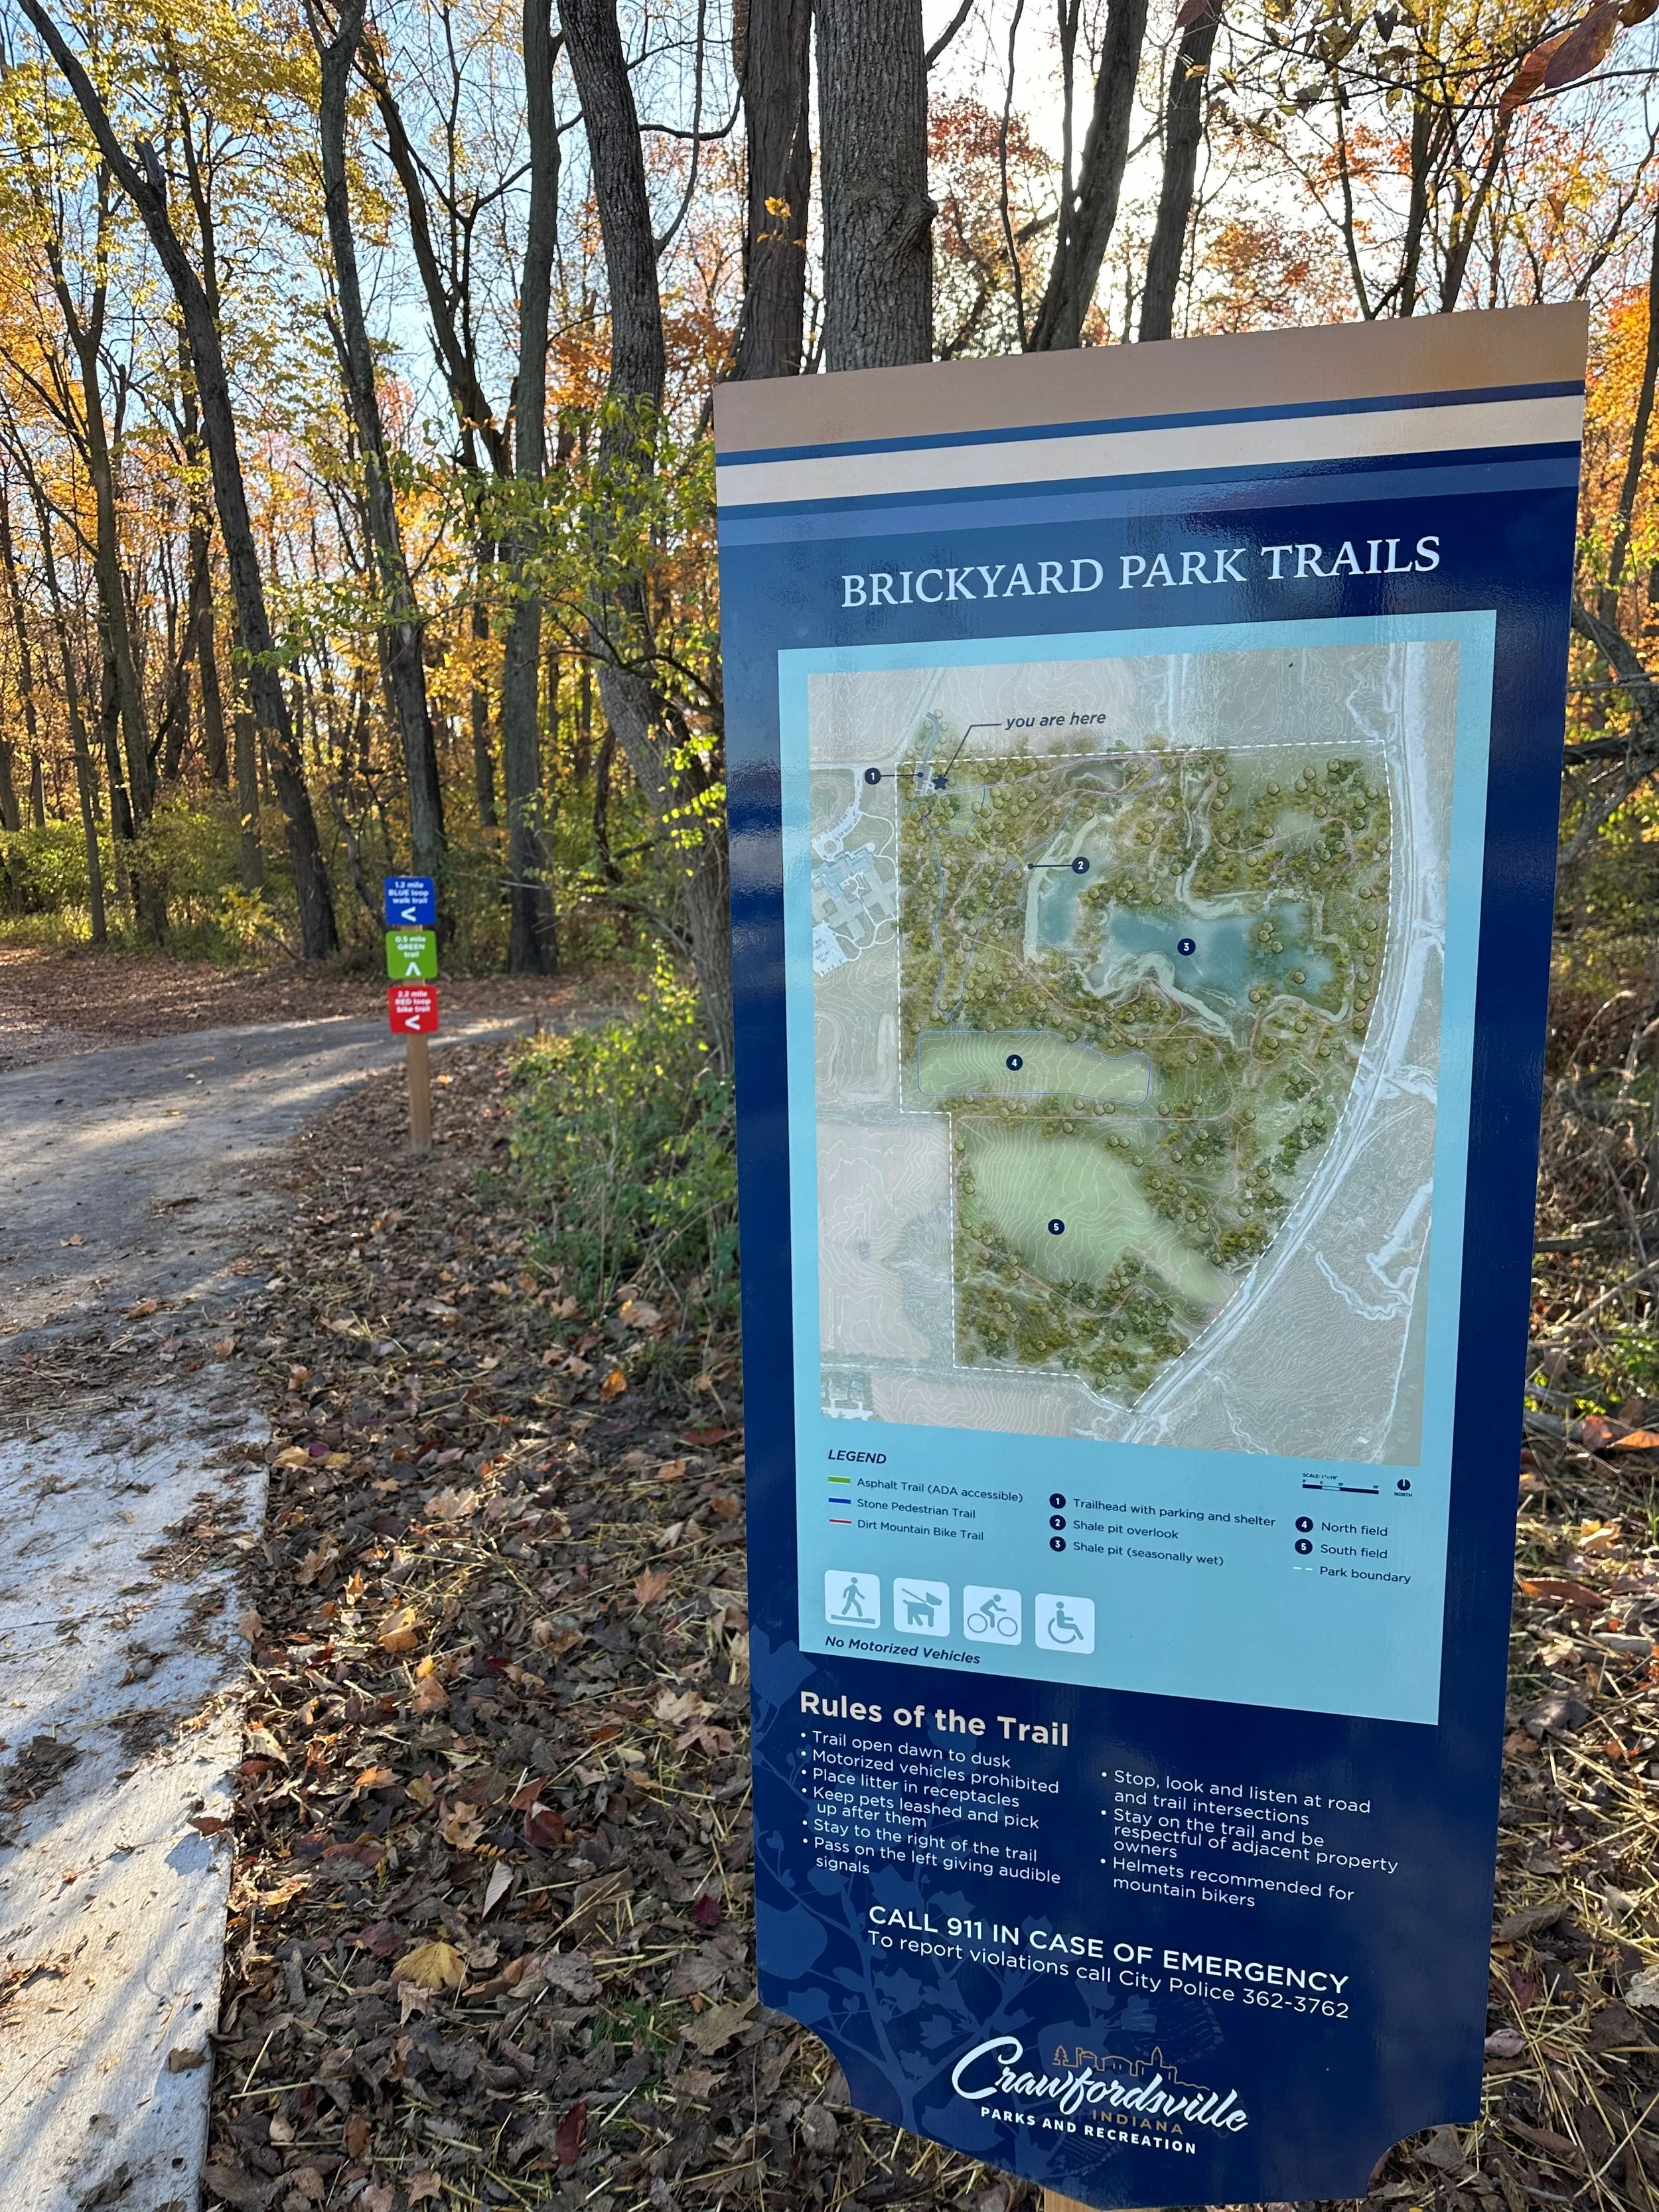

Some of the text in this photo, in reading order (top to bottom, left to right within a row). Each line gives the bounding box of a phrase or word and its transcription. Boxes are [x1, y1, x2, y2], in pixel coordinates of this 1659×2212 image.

[842, 536, 1439, 607] BRICKYARD PARK TRAILS
[1005, 712, 1106, 730] you are here
[413, 997, 431, 1006] loop
[828, 1449, 887, 1463] LEGEND
[857, 1478, 1023, 1503] Asphalt Trail (ADA accessible)
[857, 1499, 975, 1518] Stone Pedestrian Trail
[1074, 1499, 1126, 1512] Trailhead
[1131, 1505, 1155, 1514] with
[1160, 1509, 1204, 1521] parking
[1208, 1513, 1230, 1522] and
[1234, 1514, 1275, 1526] shelter
[858, 1520, 983, 1540] Dirt Mountain Bike Trail
[1074, 1520, 1104, 1531] Shale
[1108, 1525, 1123, 1534] pit
[1127, 1528, 1178, 1538] overlook
[1322, 1522, 1356, 1533] North
[1361, 1526, 1387, 1536] field
[1074, 1542, 1104, 1553] Shale
[1108, 1546, 1123, 1555] pit
[1127, 1548, 1192, 1564] (seasonally
[1196, 1556, 1223, 1566] wet)
[1321, 1544, 1356, 1556] South
[1361, 1548, 1387, 1558] field
[1321, 1566, 1411, 1584] Park boundary
[826, 1636, 980, 1664] No Motorized Vehicles
[801, 1691, 1068, 1746] Rules of the Trail
[812, 1731, 1010, 1768] Trail open dawn to dusk
[814, 1749, 1058, 1793] Motorized vehicles prohibited
[814, 1768, 1019, 1806] Place litter in receptacles
[1115, 1770, 1370, 1813] Stop, look and listen at road
[814, 1787, 1039, 1828] Keep pets leashed and pick
[818, 1804, 926, 1827] up after them
[1115, 1792, 1309, 1825] and trail intersections
[814, 1819, 1036, 1862] Stay to the right of the trail
[1114, 1808, 1324, 1846] Stay on the trail and be
[815, 1837, 1060, 1883] Pass on the left giving audible
[1114, 1841, 1177, 1858] owners
[1115, 1826, 1398, 1874] respectful of adjacent property
[817, 1858, 869, 1874] signals
[1114, 1857, 1354, 1900] Helmets recommended for
[1114, 1879, 1254, 1906] mountain bikers
[869, 1906, 1348, 1993] CALL 911 IN CASE OF EMERGENCY
[868, 1931, 1348, 2018] To report violations call City Police 362-3762
[952, 2035, 1248, 2132] Crawfordsville
[981, 2107, 1195, 2154] PARKS AND RECREATION
[1094, 2110, 1183, 2134] INDIANA
